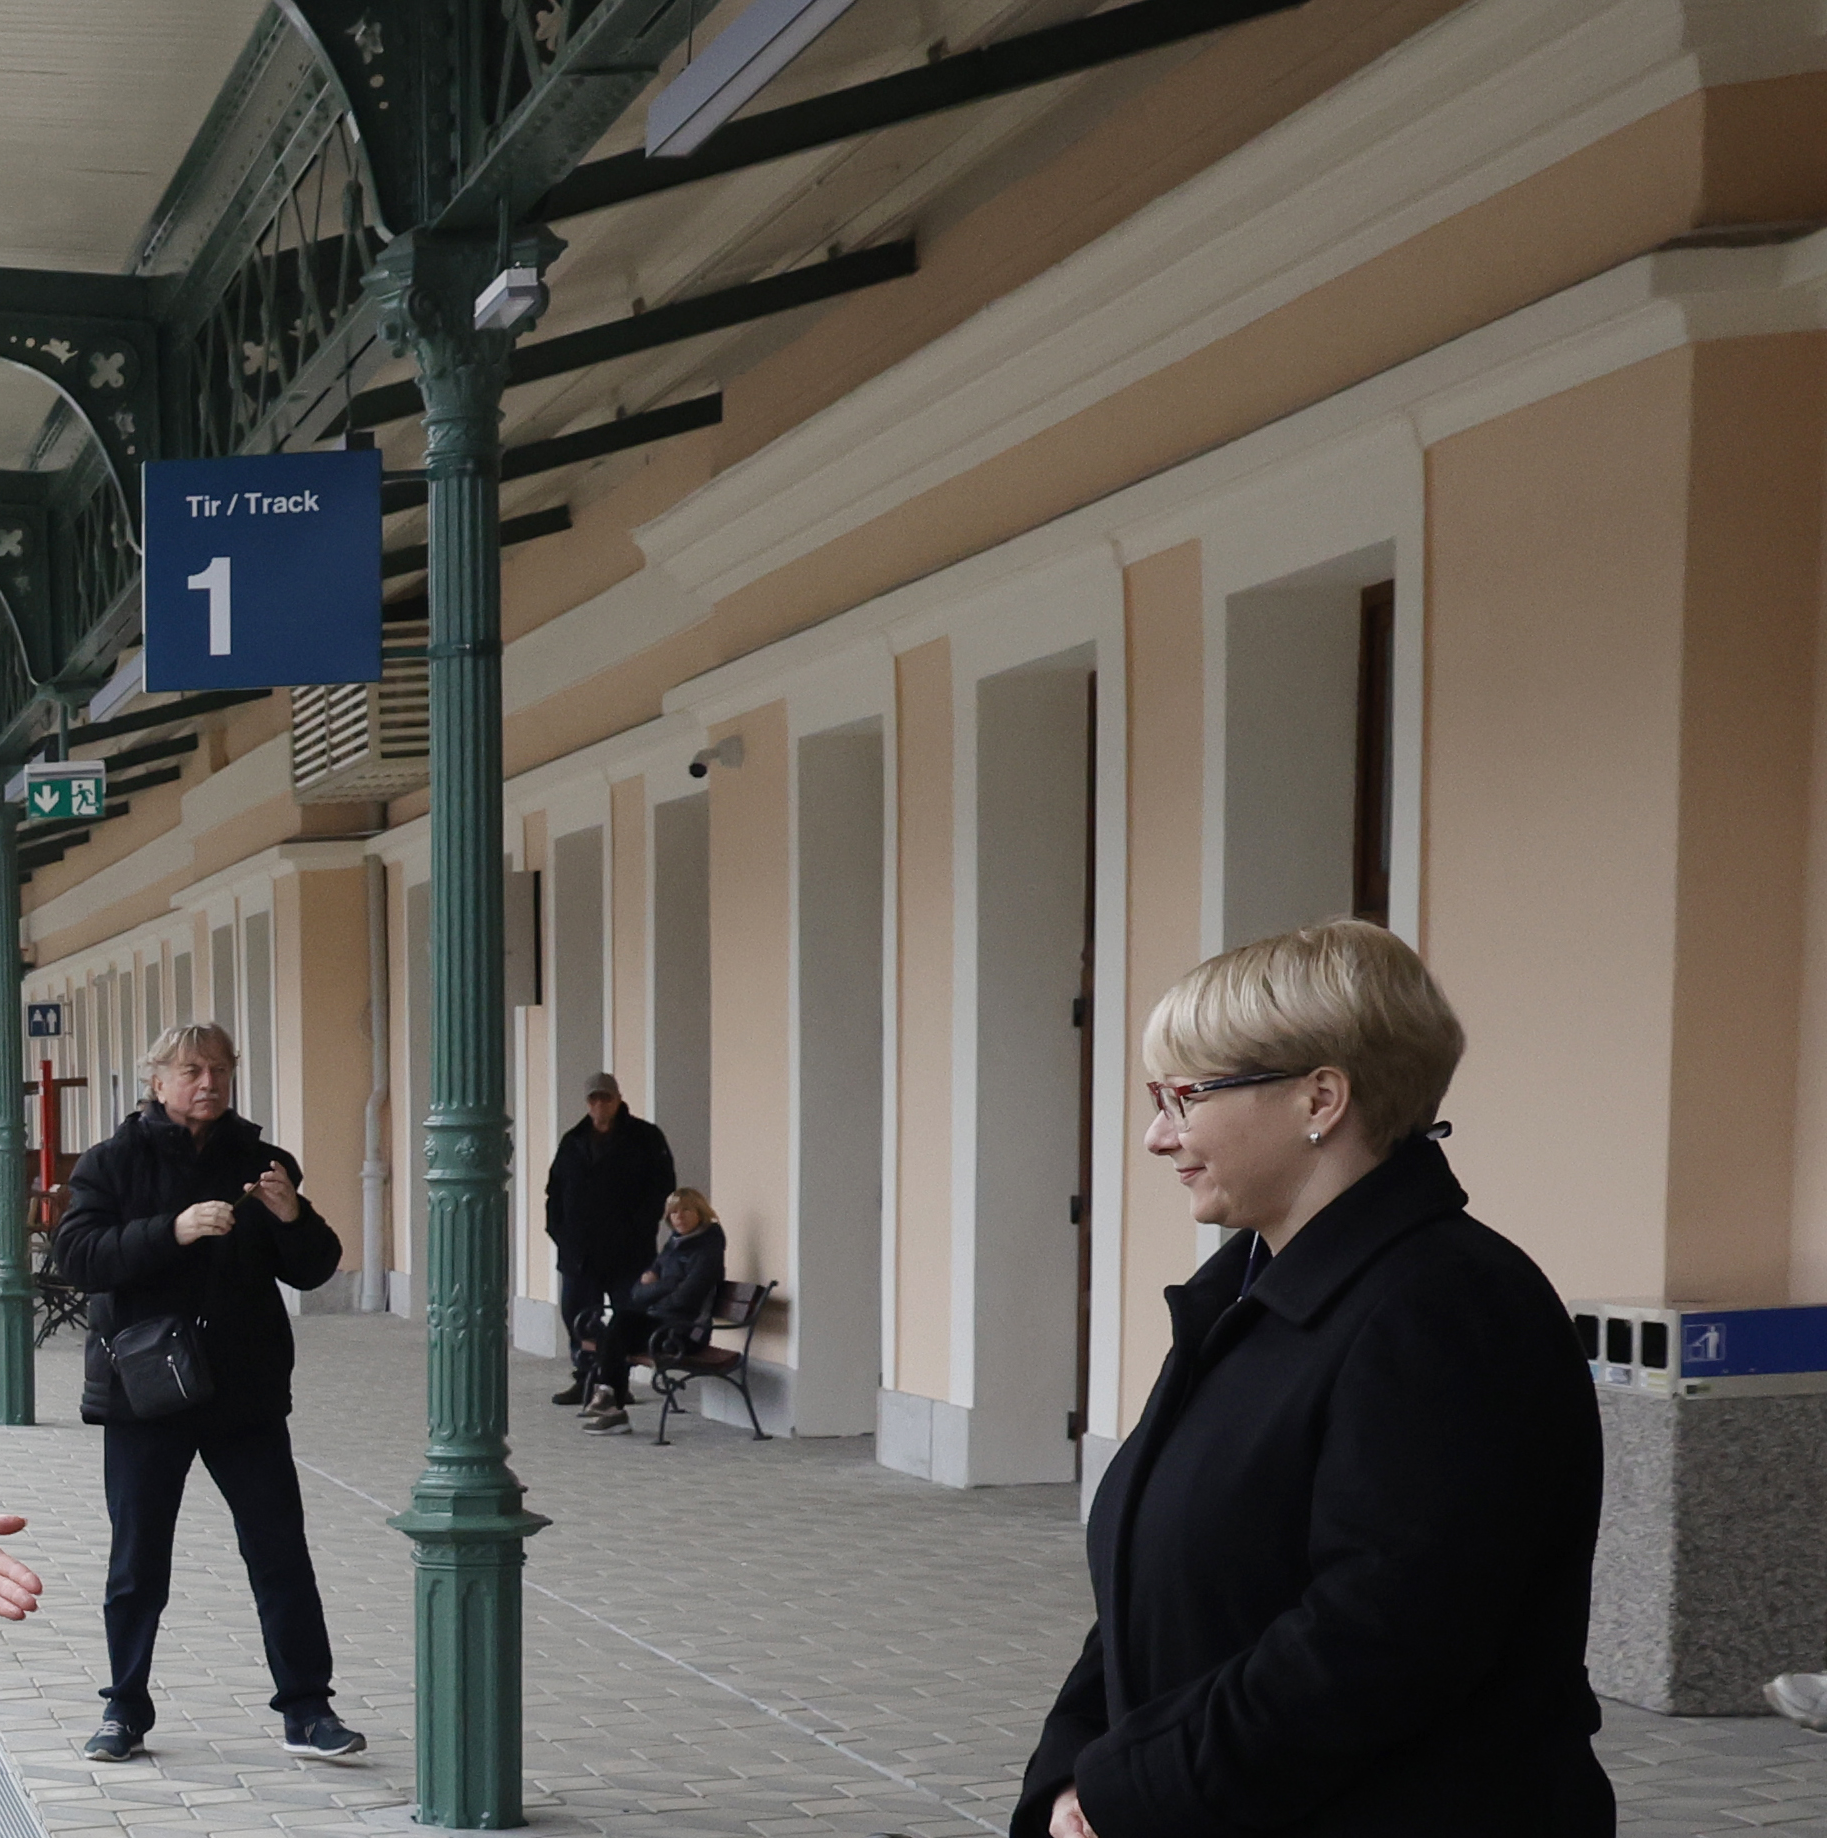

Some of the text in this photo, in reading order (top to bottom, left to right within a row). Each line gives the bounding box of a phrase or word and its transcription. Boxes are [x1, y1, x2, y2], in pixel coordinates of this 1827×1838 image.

[185, 489, 320, 518] Tir / Track
[187, 556, 231, 656] 1
